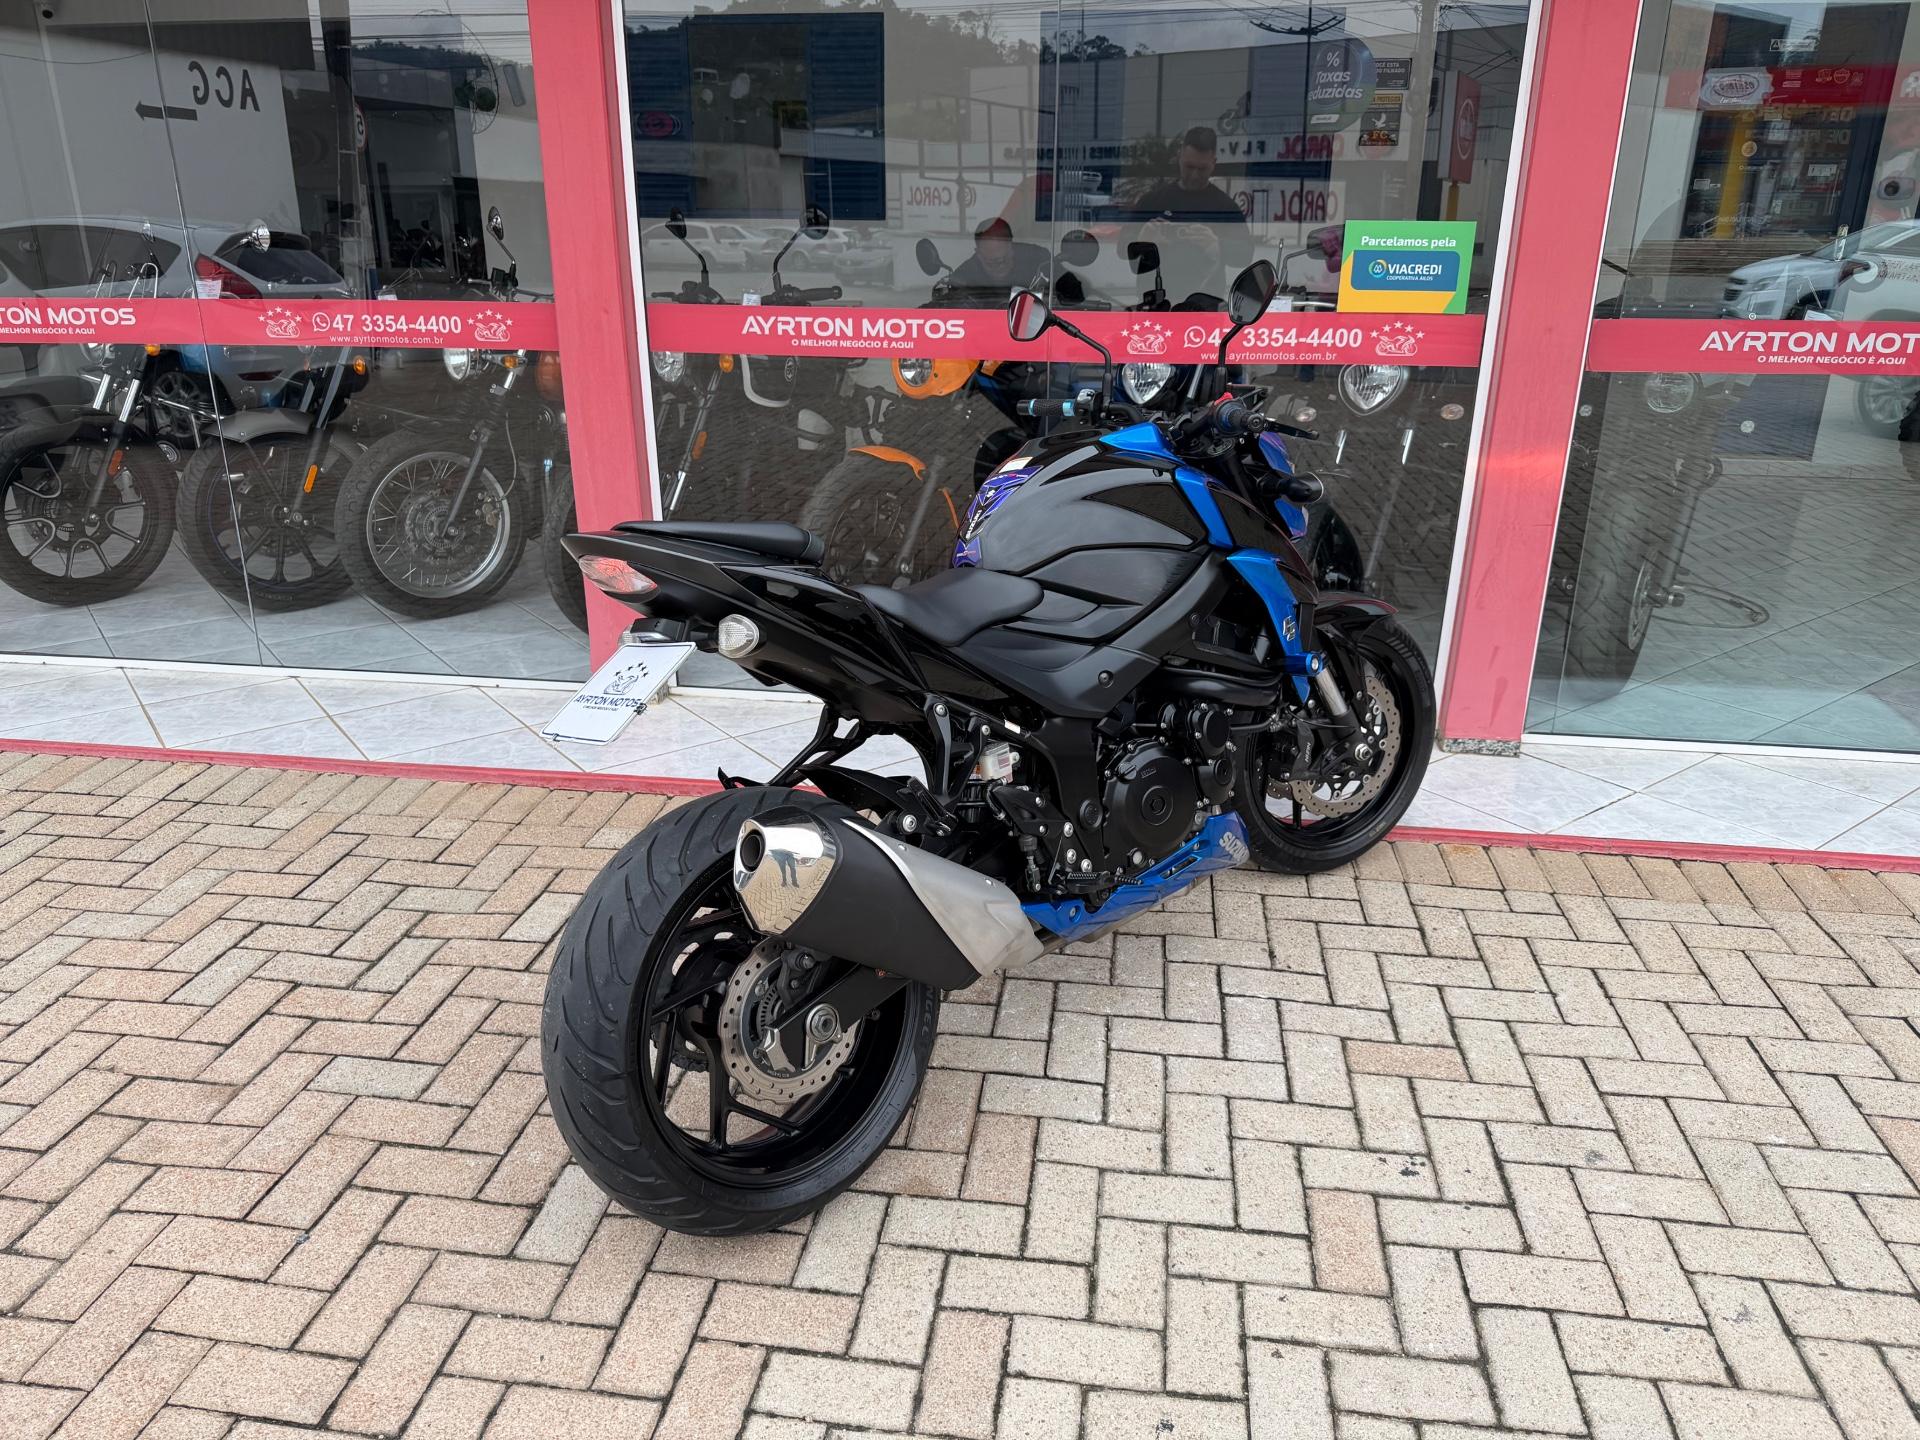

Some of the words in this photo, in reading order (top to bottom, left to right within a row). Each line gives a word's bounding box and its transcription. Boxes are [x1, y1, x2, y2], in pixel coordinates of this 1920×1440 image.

[1316, 71, 1351, 84] Taxas
[1308, 85, 1363, 100] eduzidas
[1361, 236, 1428, 247] Parcelamos
[1431, 237, 1456, 249] pela
[1388, 264, 1442, 275] VIACREDI
[47, 308, 137, 326] MOTOS
[333, 315, 354, 332] 47
[361, 315, 462, 334] 3354-4400
[742, 315, 853, 337] AYRTON
[862, 318, 965, 339] MOTOS
[329, 335, 444, 345] www.ayrtonmotos.com.br
[800, 339, 838, 347] MELHOR
[840, 339, 881, 349] NEGÓCIO
[883, 339, 889, 348] É
[890, 341, 914, 349] AQUI
[1242, 328, 1363, 348] 3354-4400
[1700, 330, 1837, 352] AYRTON
[1200, 351, 1338, 361] ww.ayrtonmotos.com.br
[1757, 355, 1767, 363] O
[1768, 355, 1813, 364] MELHOR
[1815, 355, 1866, 365] NEGÓCIO
[1868, 356, 1876, 365] É
[1877, 357, 1906, 365] AQUI
[965, 509, 983, 540] SUZUKI
[574, 694, 610, 705] AYRTON
[609, 697, 641, 708] MOTOS
